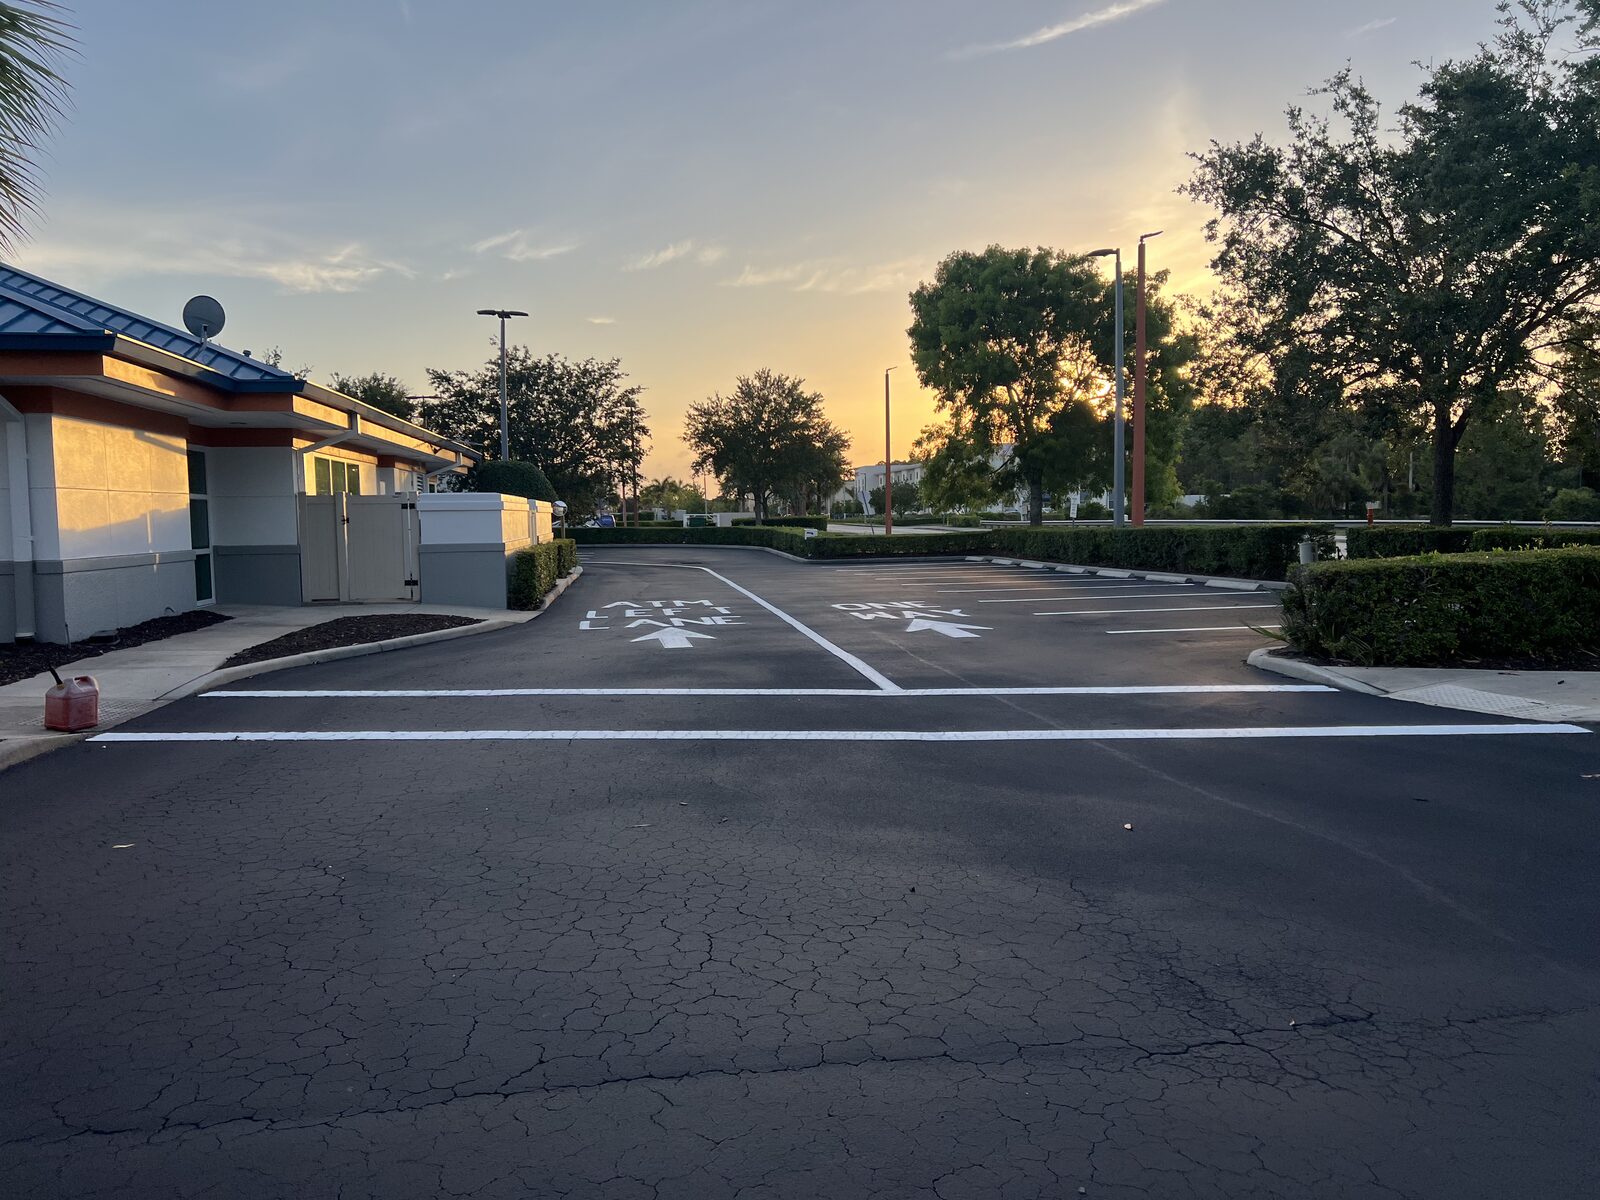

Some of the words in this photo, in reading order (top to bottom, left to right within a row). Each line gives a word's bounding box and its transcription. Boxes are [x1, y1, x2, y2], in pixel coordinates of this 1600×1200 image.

[601, 599, 714, 609] ATM
[831, 600, 941, 611] ONE
[586, 606, 732, 619] LEFT
[850, 608, 971, 620] WAY
[579, 615, 747, 630] LANE
